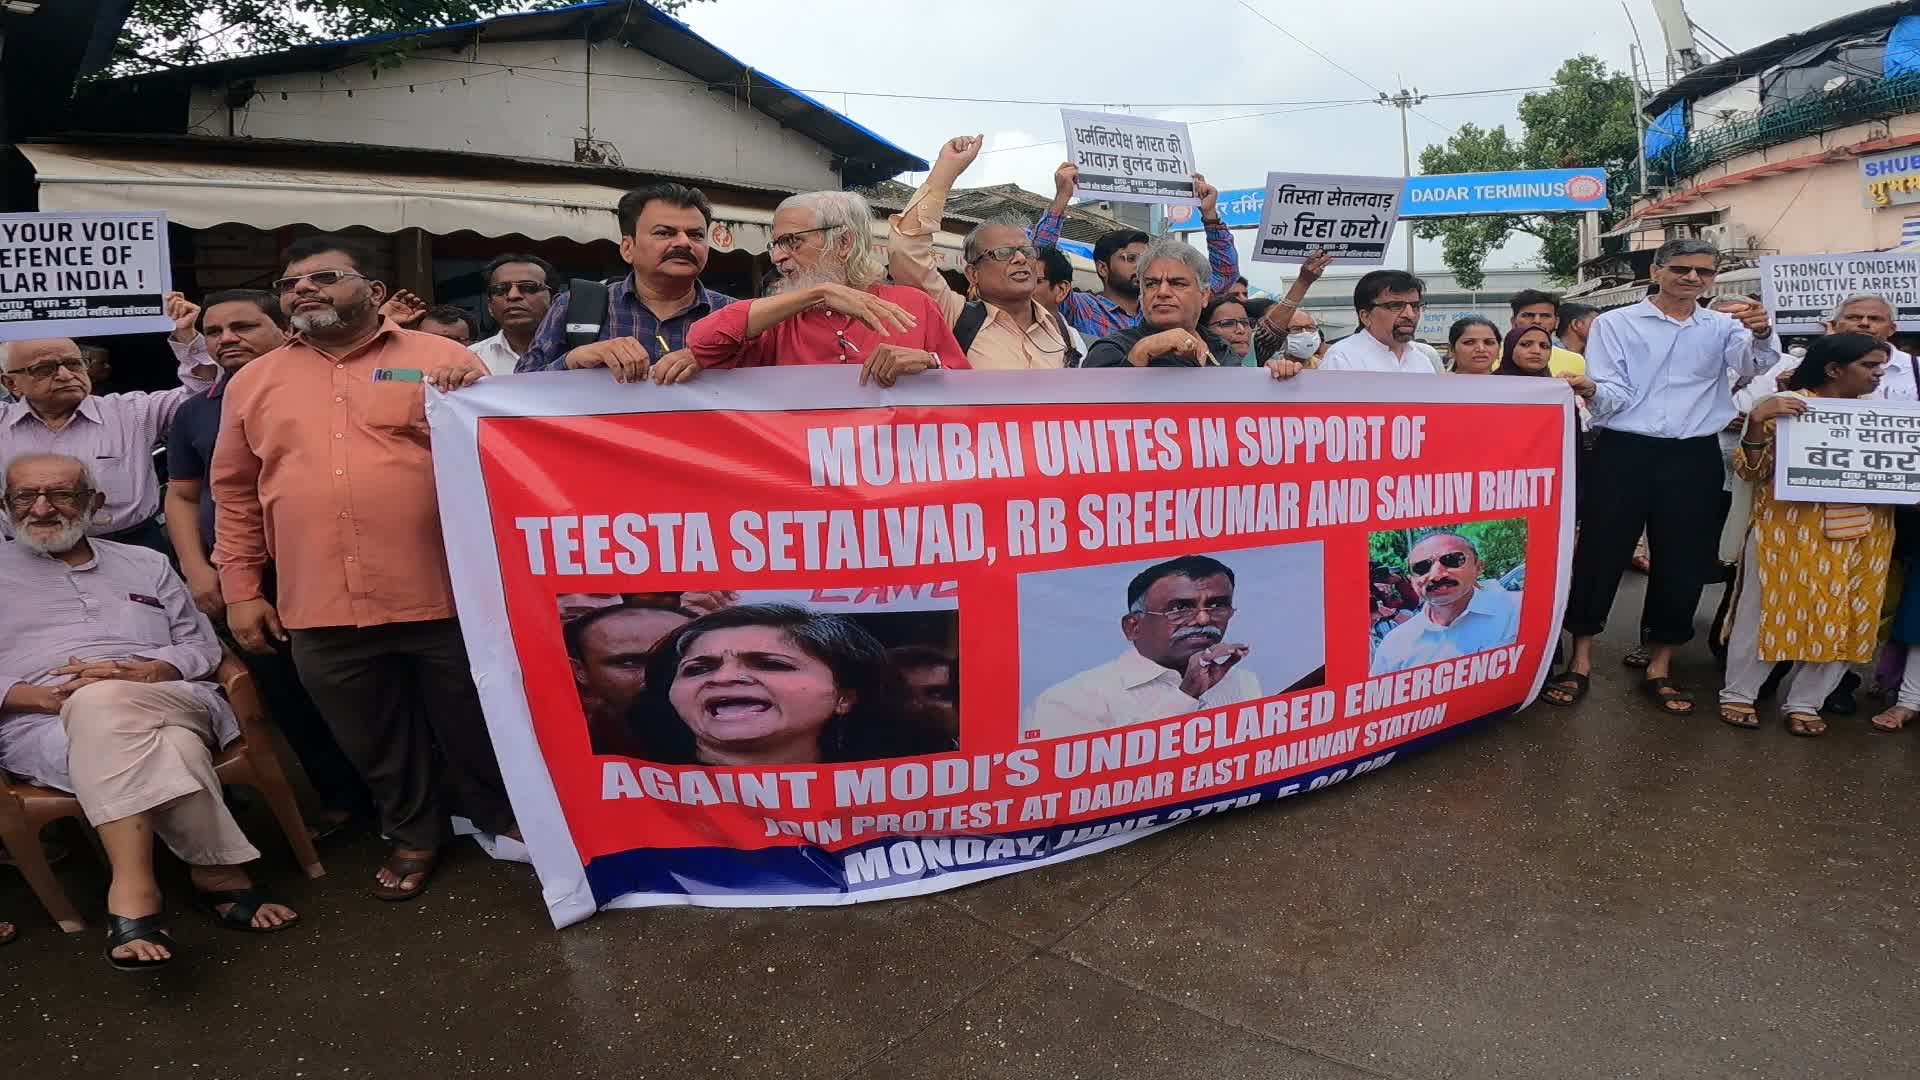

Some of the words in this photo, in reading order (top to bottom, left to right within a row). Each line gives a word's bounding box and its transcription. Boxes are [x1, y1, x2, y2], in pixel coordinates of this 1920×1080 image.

[1074, 125, 1134, 151] धर्मनिरपेक्ष
[1136, 135, 1166, 153] भारत
[1166, 133, 1183, 155] की
[1078, 151, 1119, 172] आवाज़
[1121, 153, 1153, 176] बुलंद
[1865, 154, 1920, 177] SHUB
[1231, 192, 1265, 215] टर्मि
[1278, 184, 1324, 206] तिस्ता
[1327, 186, 1395, 213] सेतलवाड़
[1411, 186, 1469, 203] DADAR
[1473, 182, 1567, 201] TERMINUS
[2, 223, 74, 243] YOUR
[82, 221, 154, 242] VOICE
[1271, 221, 1289, 237] को
[1293, 212, 1337, 239] रिहा
[0, 246, 93, 268] EFENCE
[102, 245, 132, 266] OF
[1773, 262, 1844, 278] STRONGLY
[1849, 259, 1918, 275] CONDEMN
[0, 272, 48, 293] LAR
[57, 270, 128, 291] INDIA
[1773, 277, 1857, 293] VINDICTIVE
[1862, 276, 1919, 290] ARREST
[68, 298, 87, 308] SFI
[1778, 295, 1794, 307] OF
[1799, 293, 1844, 307] TEESTA
[1857, 409, 1920, 429] सेतल
[1828, 426, 1851, 439] को
[1855, 428, 1920, 445] सतान
[807, 422, 1025, 488] MUMBAI
[1037, 419, 1180, 477] UNITES
[1188, 417, 1229, 468] IN
[1238, 415, 1384, 465] SUPPORT
[1391, 415, 1426, 460] OF
[1804, 441, 1854, 469] बंद
[515, 511, 719, 576] TEESTA
[729, 502, 997, 572] SETALVAD,
[1006, 497, 1068, 557] RB
[1078, 484, 1302, 551] SREEKUMAR
[1306, 479, 1370, 528] AND
[1376, 472, 1473, 521] SANJIV
[1477, 468, 1556, 513] BHATT
[602, 761, 817, 810] AGAINT
[1054, 689, 1336, 780] UNDECLARED
[1343, 645, 1526, 719] EMERGENCY
[764, 816, 842, 846] JOIN
[851, 798, 1014, 837] PROTEST
[1019, 792, 1063, 823] AT
[1068, 771, 1174, 815] DADAR
[1181, 754, 1250, 794] EAST
[1255, 725, 1361, 776] RAILWAY
[1363, 702, 1448, 748] STATION
[844, 834, 1048, 885] MONDAY,
[1052, 814, 1159, 850] JUNE
